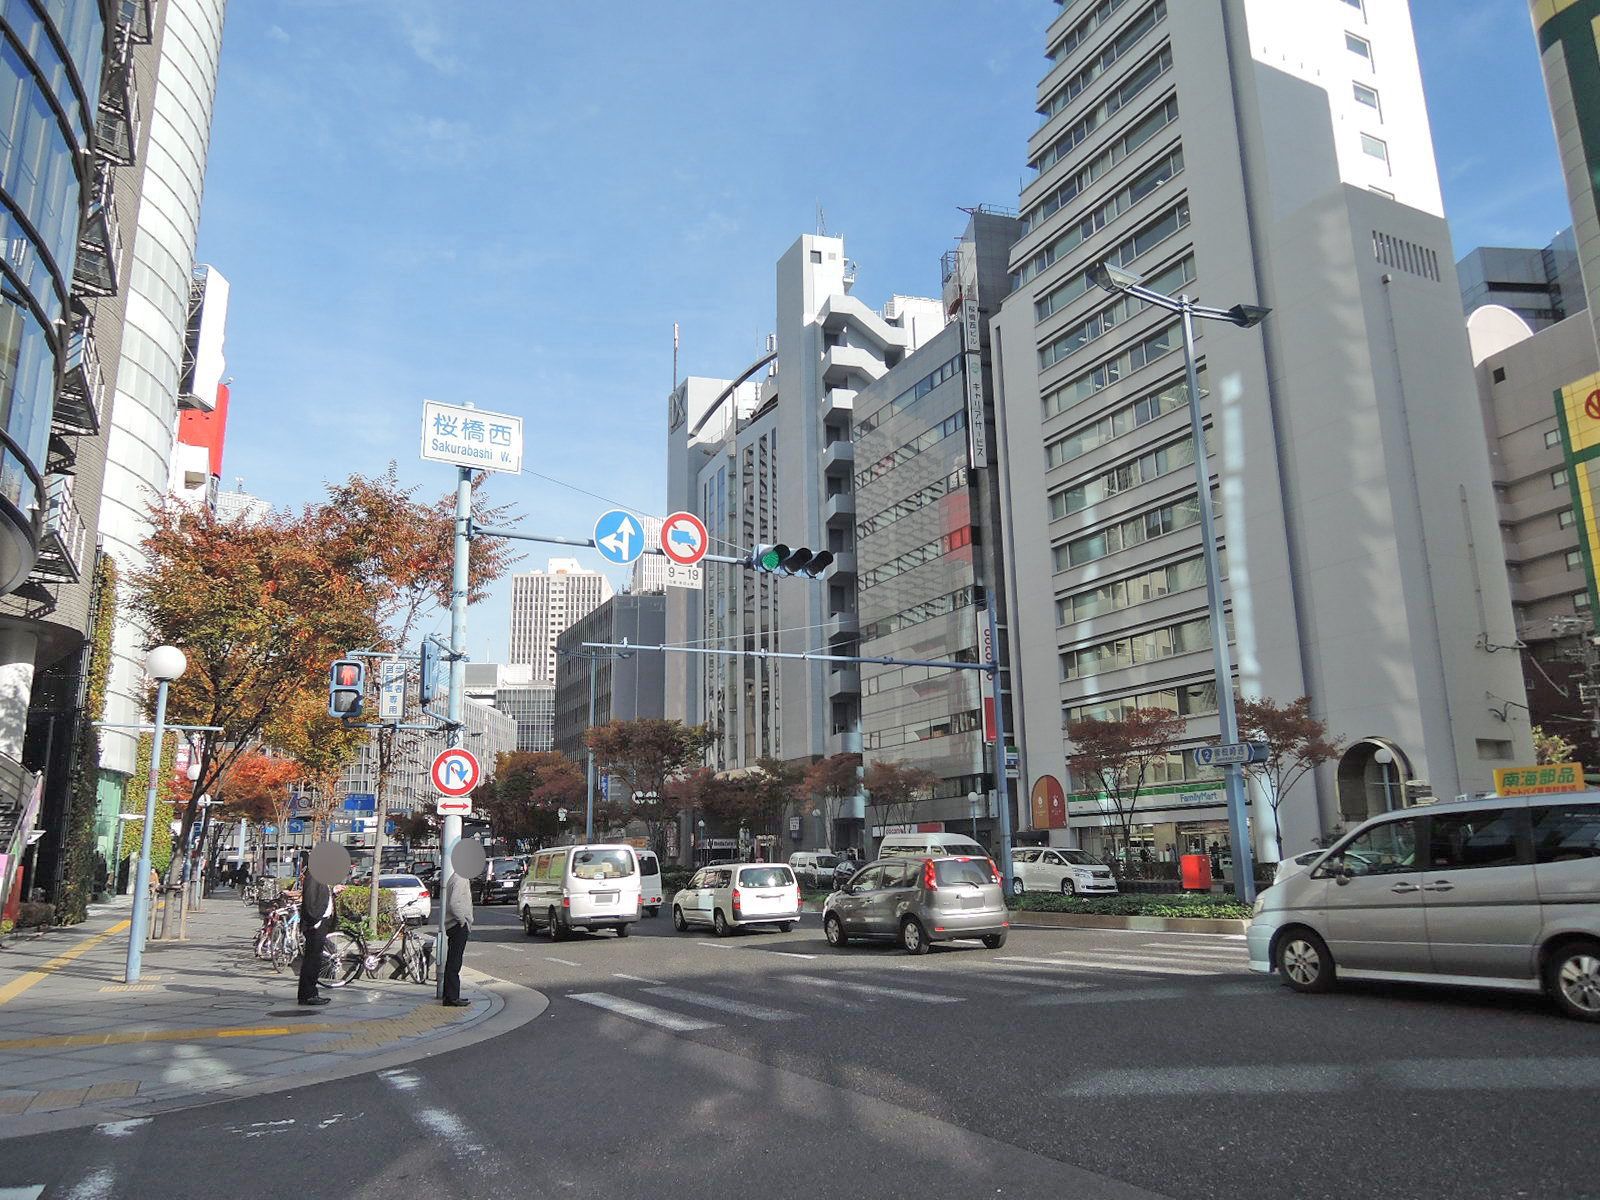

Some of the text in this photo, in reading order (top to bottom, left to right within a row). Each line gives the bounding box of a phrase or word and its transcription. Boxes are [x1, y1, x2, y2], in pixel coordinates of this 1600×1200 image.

[433, 413, 513, 447] 桜橋西
[973, 383, 984, 457] キャリアサービス
[431, 438, 493, 460] Sakurabashi
[1503, 767, 1575, 788] 南海部品
[1180, 791, 1217, 804] FamilyMart
